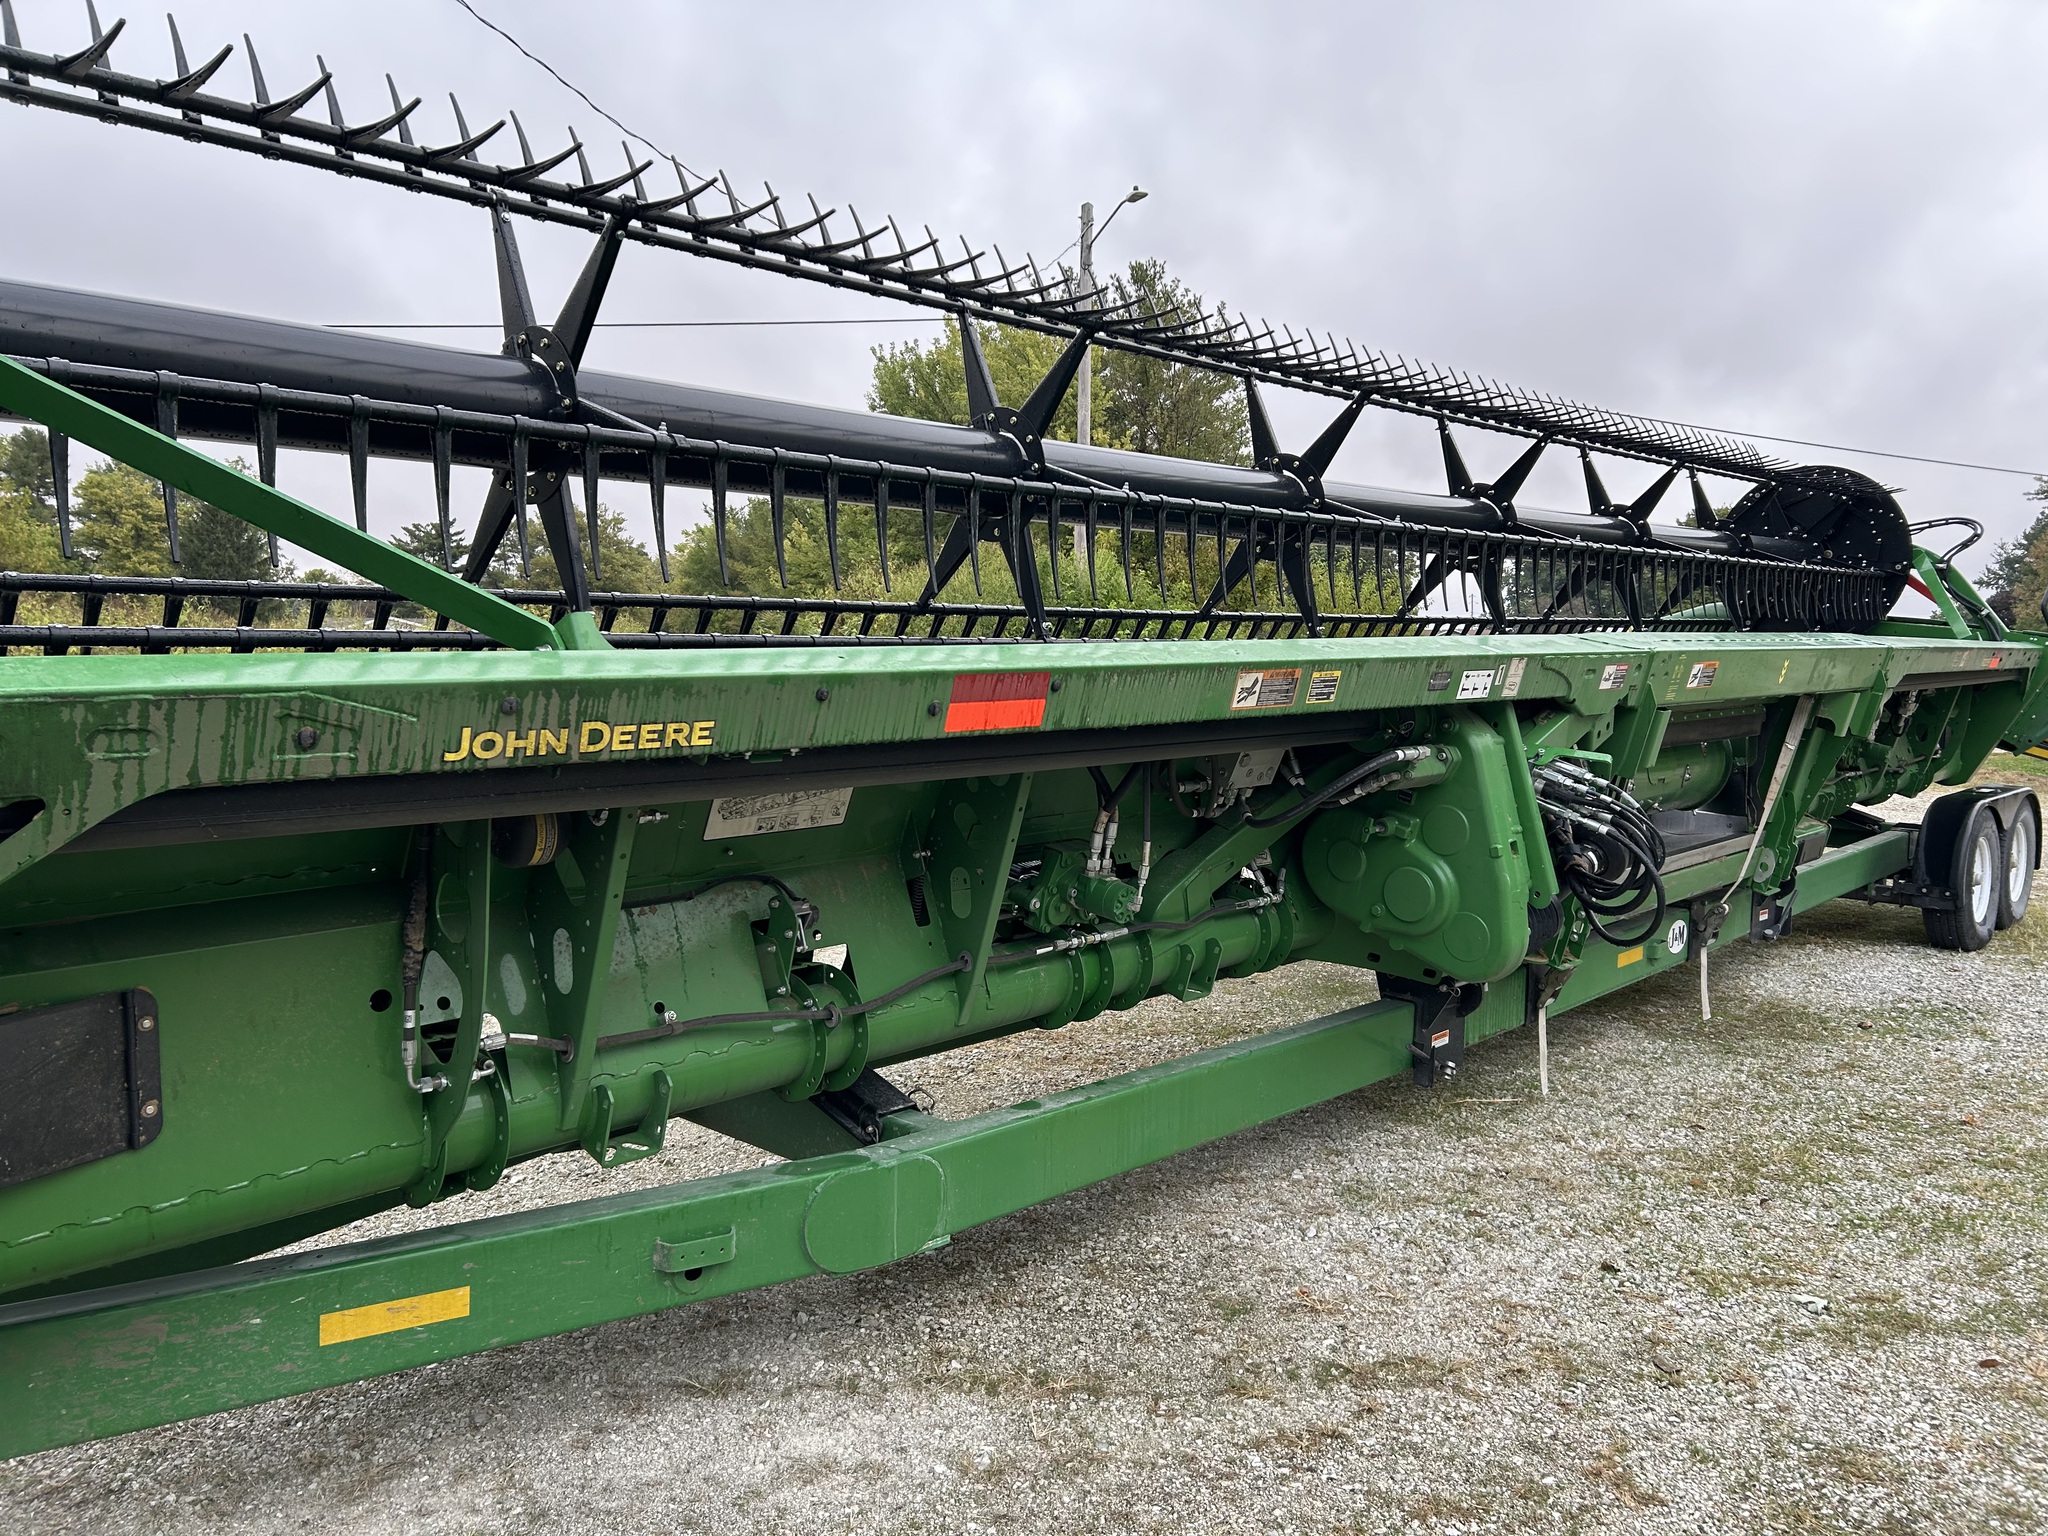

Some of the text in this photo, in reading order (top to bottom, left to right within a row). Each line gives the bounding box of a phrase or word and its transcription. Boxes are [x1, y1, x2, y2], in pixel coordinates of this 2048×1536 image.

[443, 720, 716, 762] JOHN DEERE
[537, 823, 545, 847] CAUTION
[1669, 924, 1686, 949] J&M
